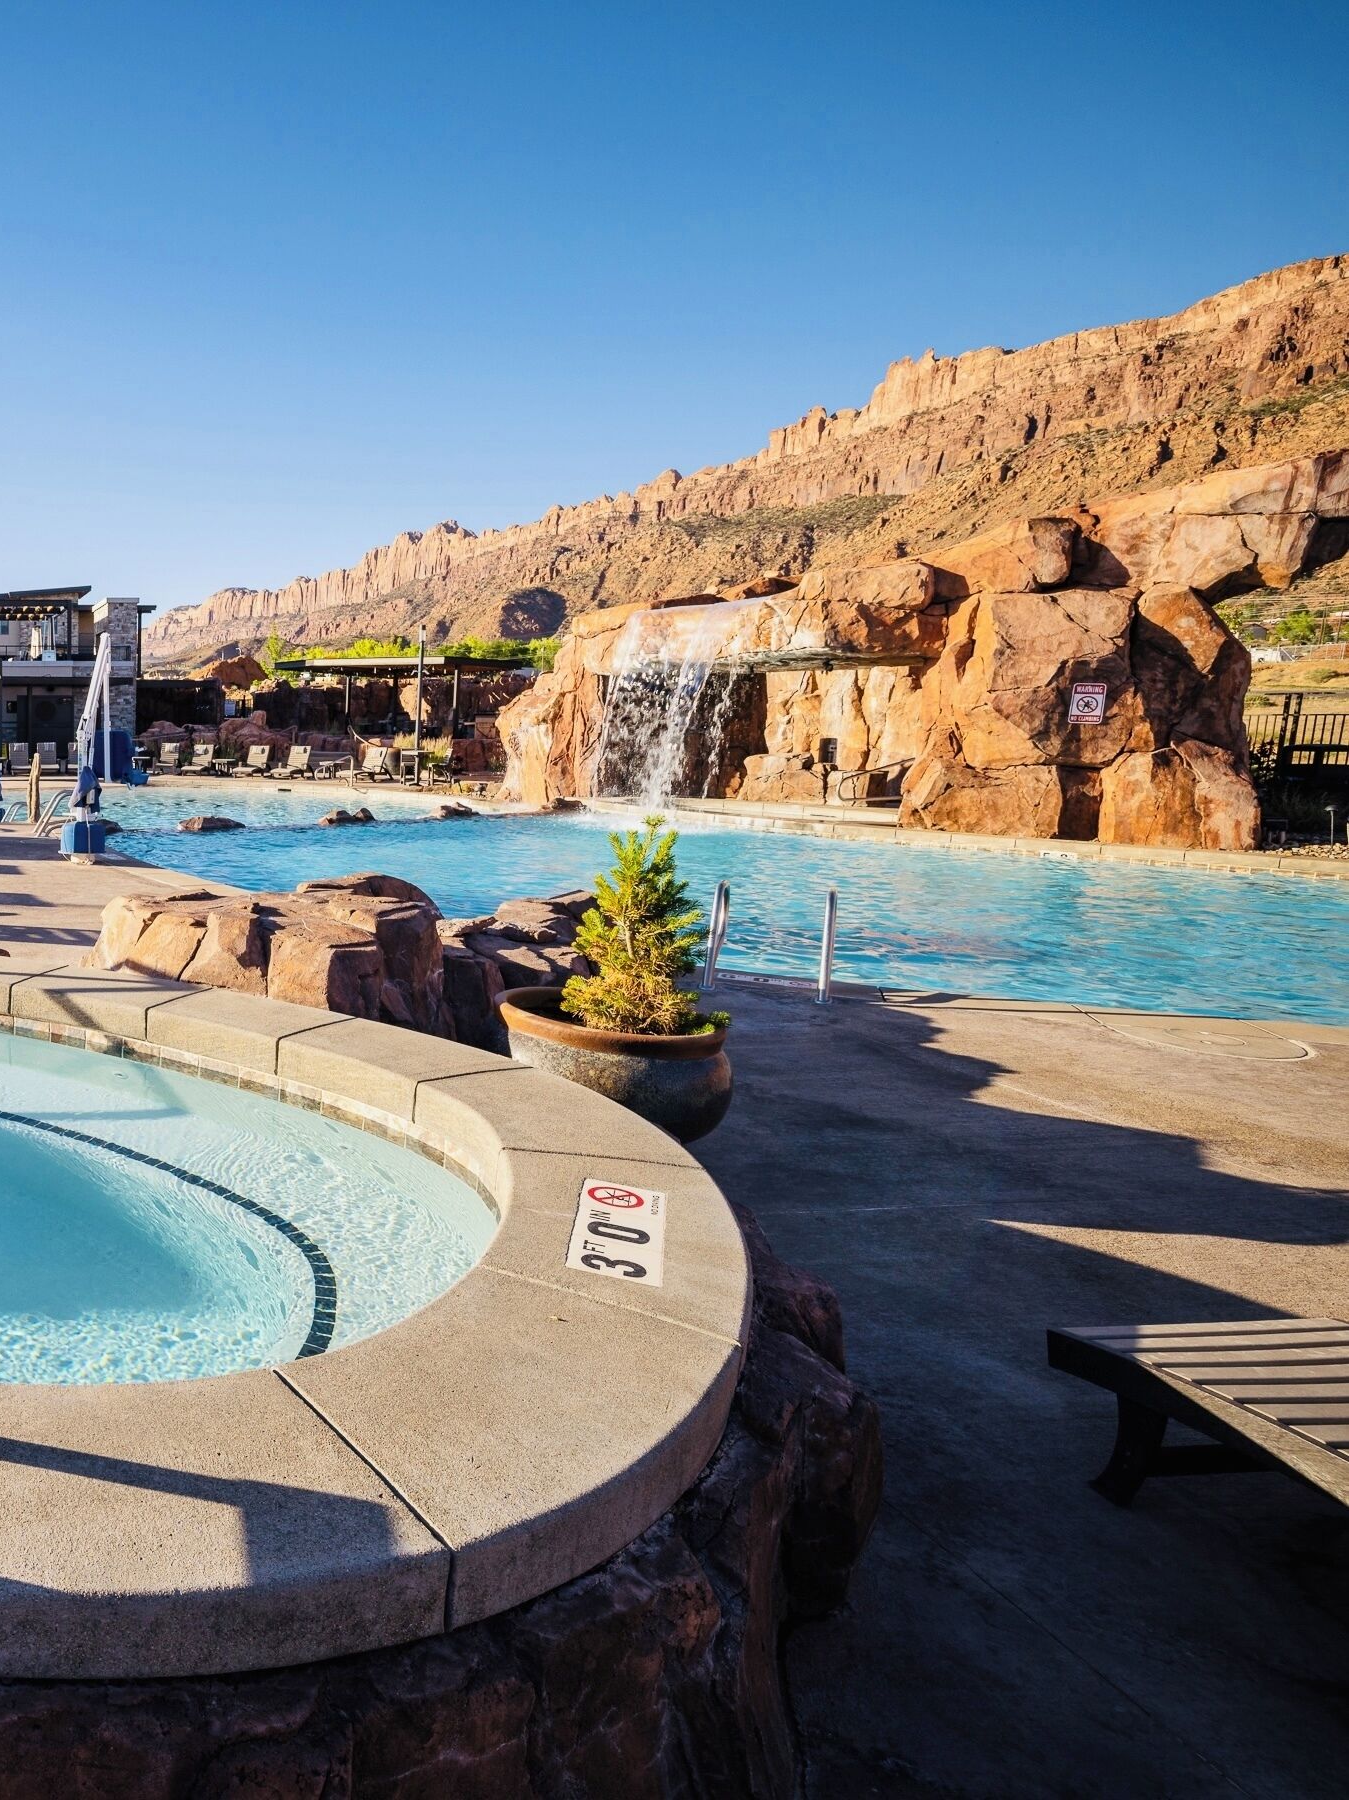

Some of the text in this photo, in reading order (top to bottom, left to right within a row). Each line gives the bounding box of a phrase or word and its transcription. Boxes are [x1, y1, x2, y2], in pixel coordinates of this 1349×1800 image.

[581, 1209, 651, 1278] 3 FT 0 IN
